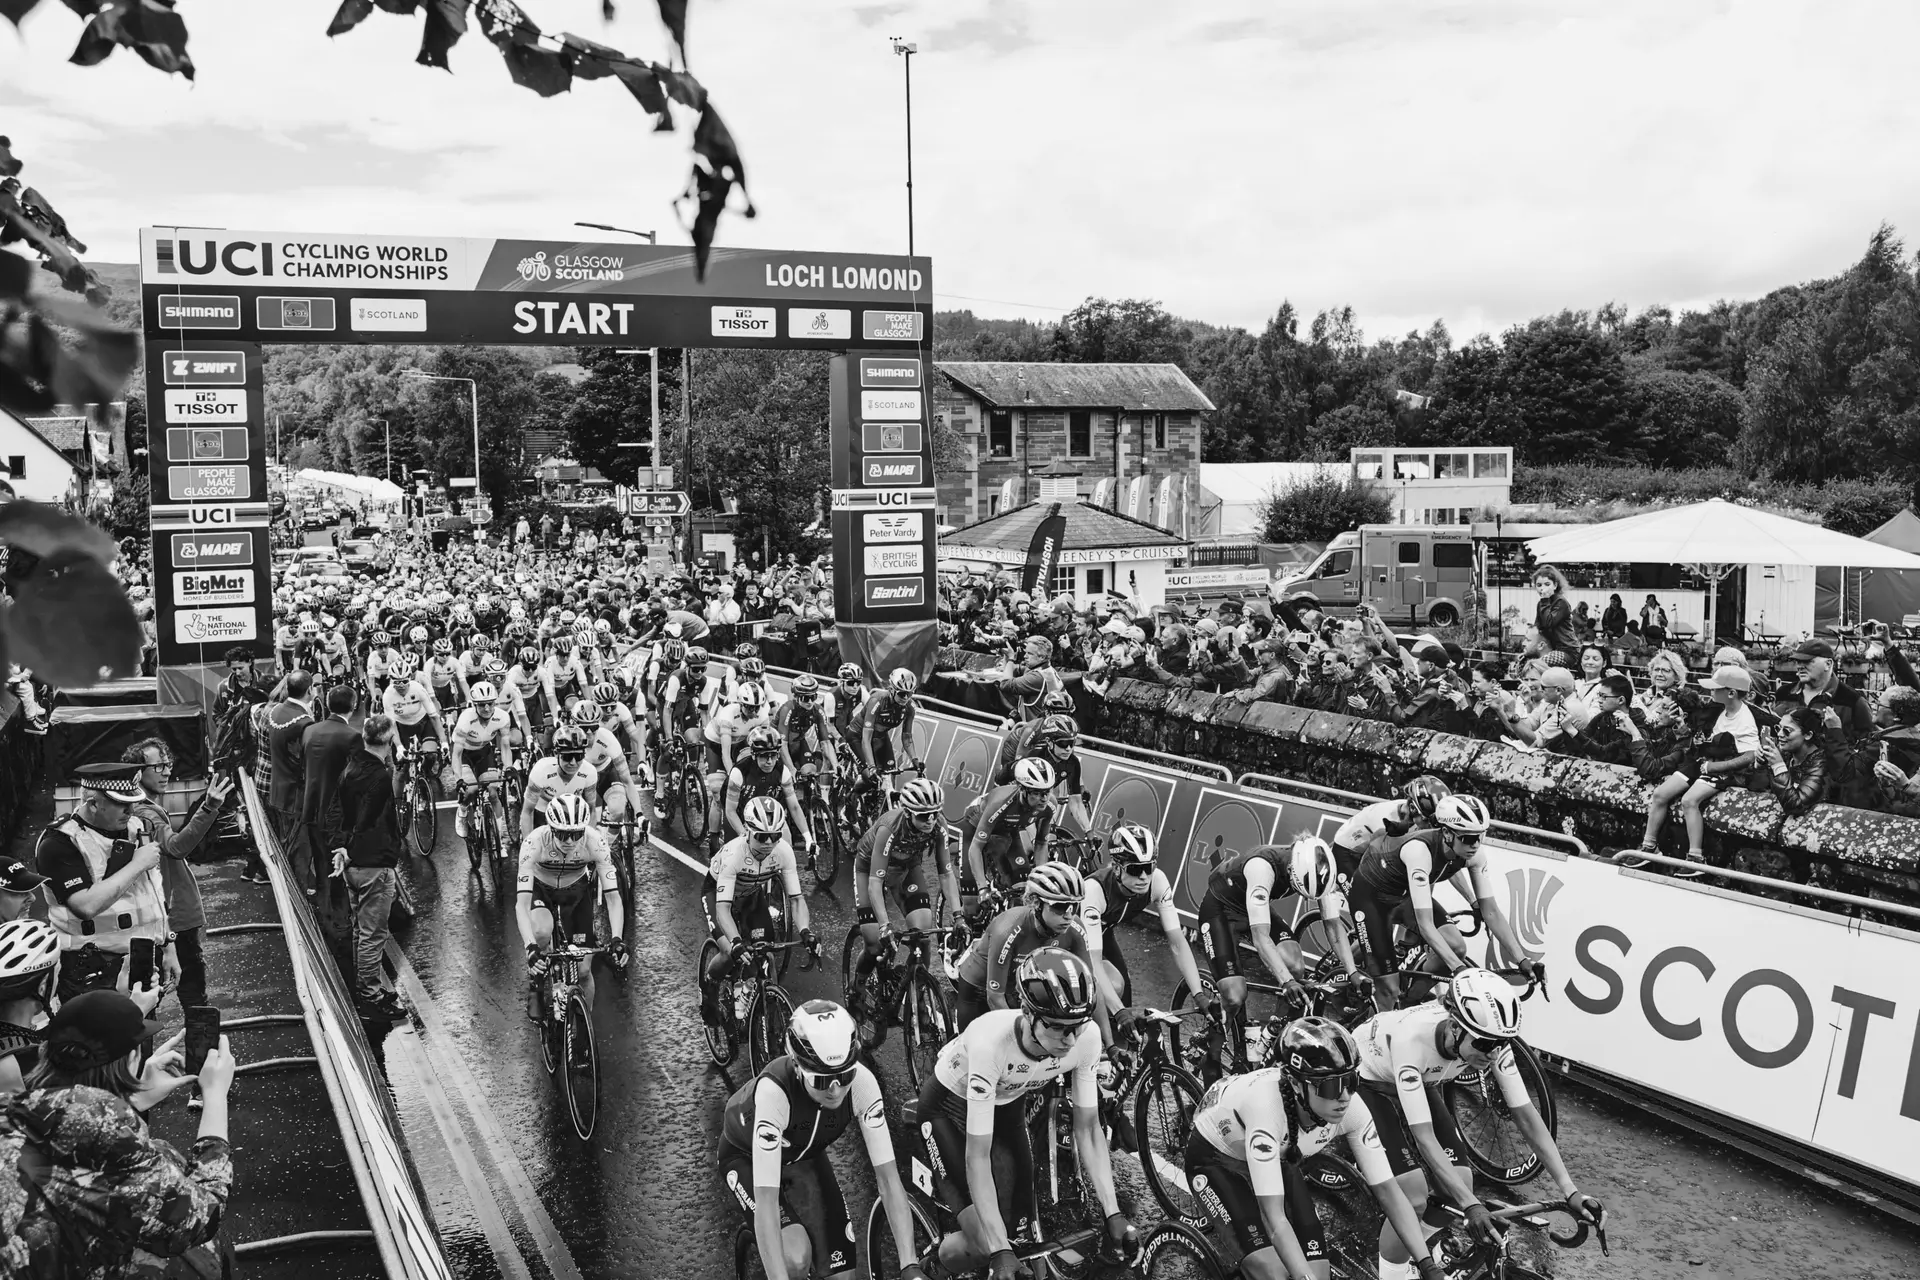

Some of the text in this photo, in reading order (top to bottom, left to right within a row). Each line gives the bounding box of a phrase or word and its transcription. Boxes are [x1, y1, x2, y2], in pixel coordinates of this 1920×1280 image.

[179, 240, 274, 277] UCI
[282, 243, 448, 262] CYCLING WORLD
[554, 255, 624, 268] GLASGOW
[283, 262, 449, 281] CHAMPIONSHIPS
[555, 268, 624, 281] SCOTLAND
[765, 263, 922, 291] LOCH LOMOND
[165, 306, 234, 318] SHIMANO
[367, 310, 419, 319] SCOTLAND
[512, 300, 634, 335] START
[885, 313, 913, 322] PEOPLE
[719, 319, 769, 330] TISSOT
[891, 322, 913, 330] MAKE
[874, 329, 913, 338] GLASGOW
[193, 362, 237, 374] ZWIFT
[866, 368, 915, 378] SHIMANO
[174, 403, 238, 415] TISSOT
[874, 401, 916, 409] SCOTLAND
[198, 468, 236, 478] PEOPLE
[883, 464, 916, 476] MAPEI
[206, 477, 236, 487] MAKE
[184, 487, 236, 496] GLASGOW
[654, 495, 671, 503] Loch
[834, 493, 848, 506] UCI
[878, 492, 908, 506] UCI
[192, 508, 231, 524] UCI
[869, 528, 917, 538] Peter Vardy
[200, 542, 244, 556] MAPEI
[1060, 546, 1184, 563] EENEY'S CRUISES
[882, 552, 918, 560] BRITISH
[882, 560, 918, 568] CYCLING
[182, 575, 245, 594] BigMat
[1173, 576, 1191, 585] UCI
[871, 585, 918, 599] Santini
[207, 621, 247, 629] NATIONAL
[207, 628, 244, 637] LOTTERY
[1340, 899, 1346, 908] 7
[918, 1174, 925, 1188] 4
[1199, 1191, 1219, 1219] LOTERIJ
[1203, 1184, 1232, 1226] NEDERLANDSE
